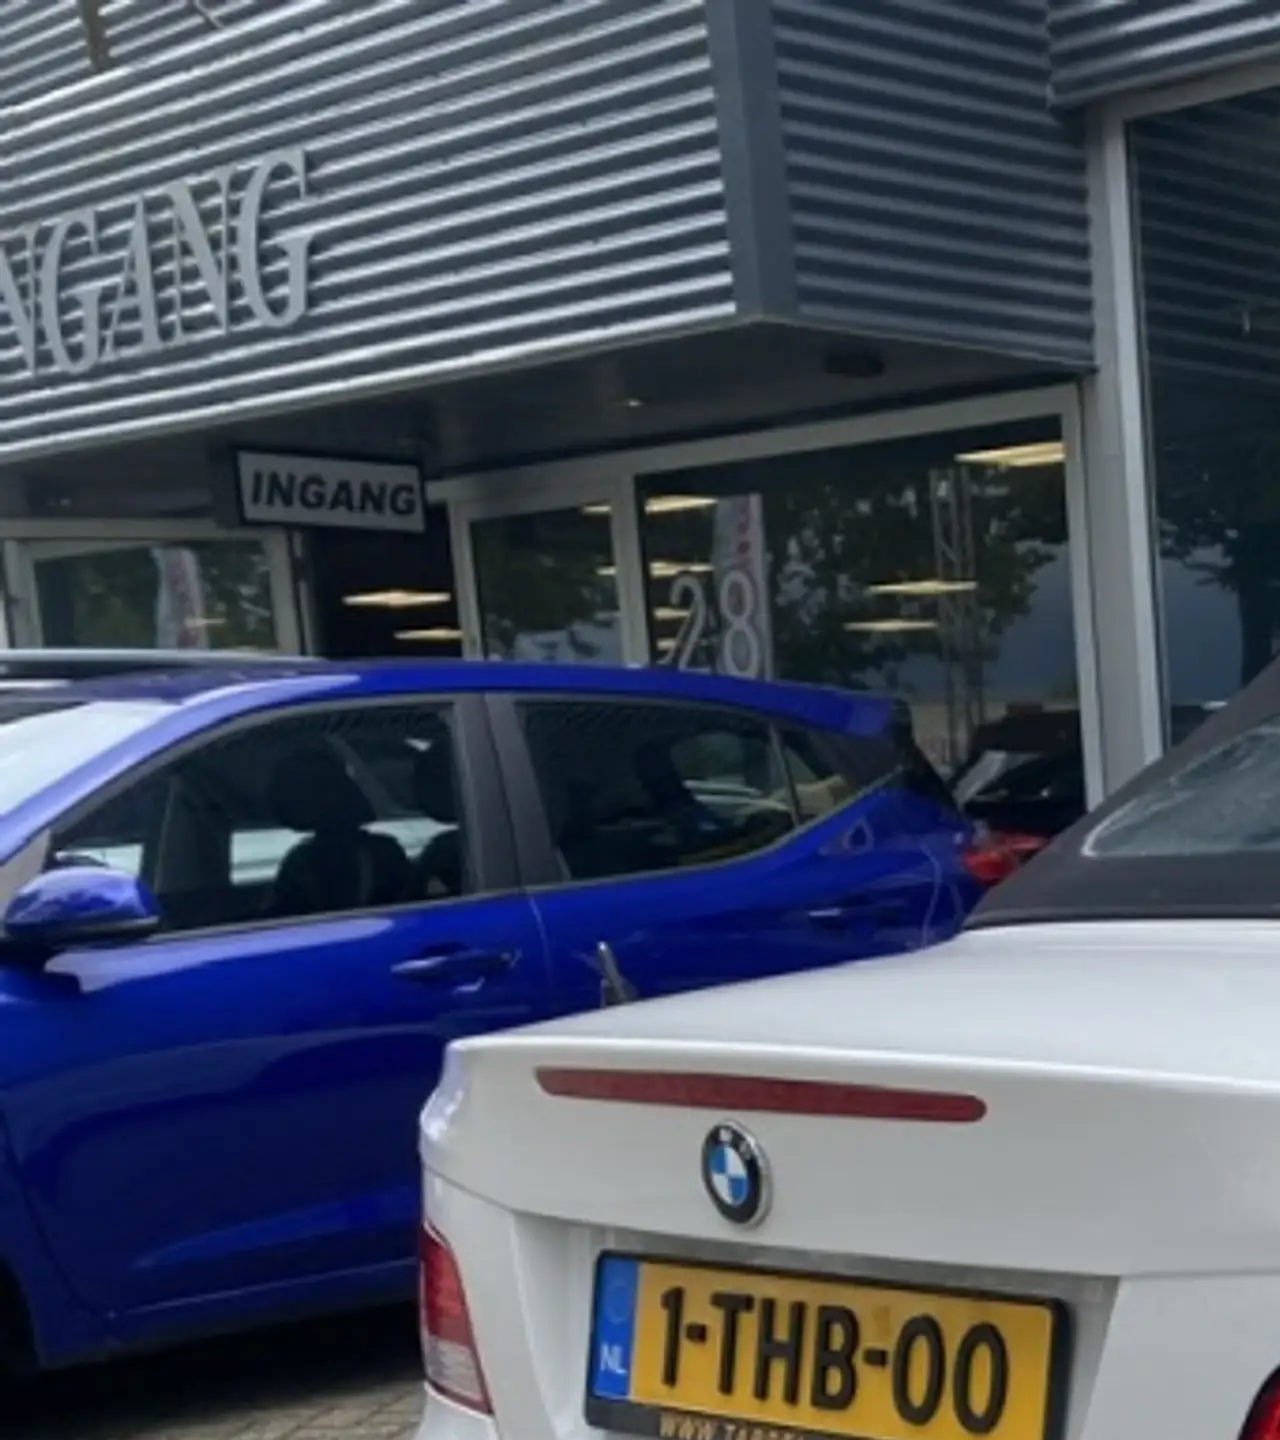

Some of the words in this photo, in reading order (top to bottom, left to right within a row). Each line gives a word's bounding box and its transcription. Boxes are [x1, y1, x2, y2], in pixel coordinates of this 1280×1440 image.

[250, 470, 417, 518] INGANG
[600, 1345, 628, 1376] NL
[659, 1285, 1010, 1436] 1-THB-00
